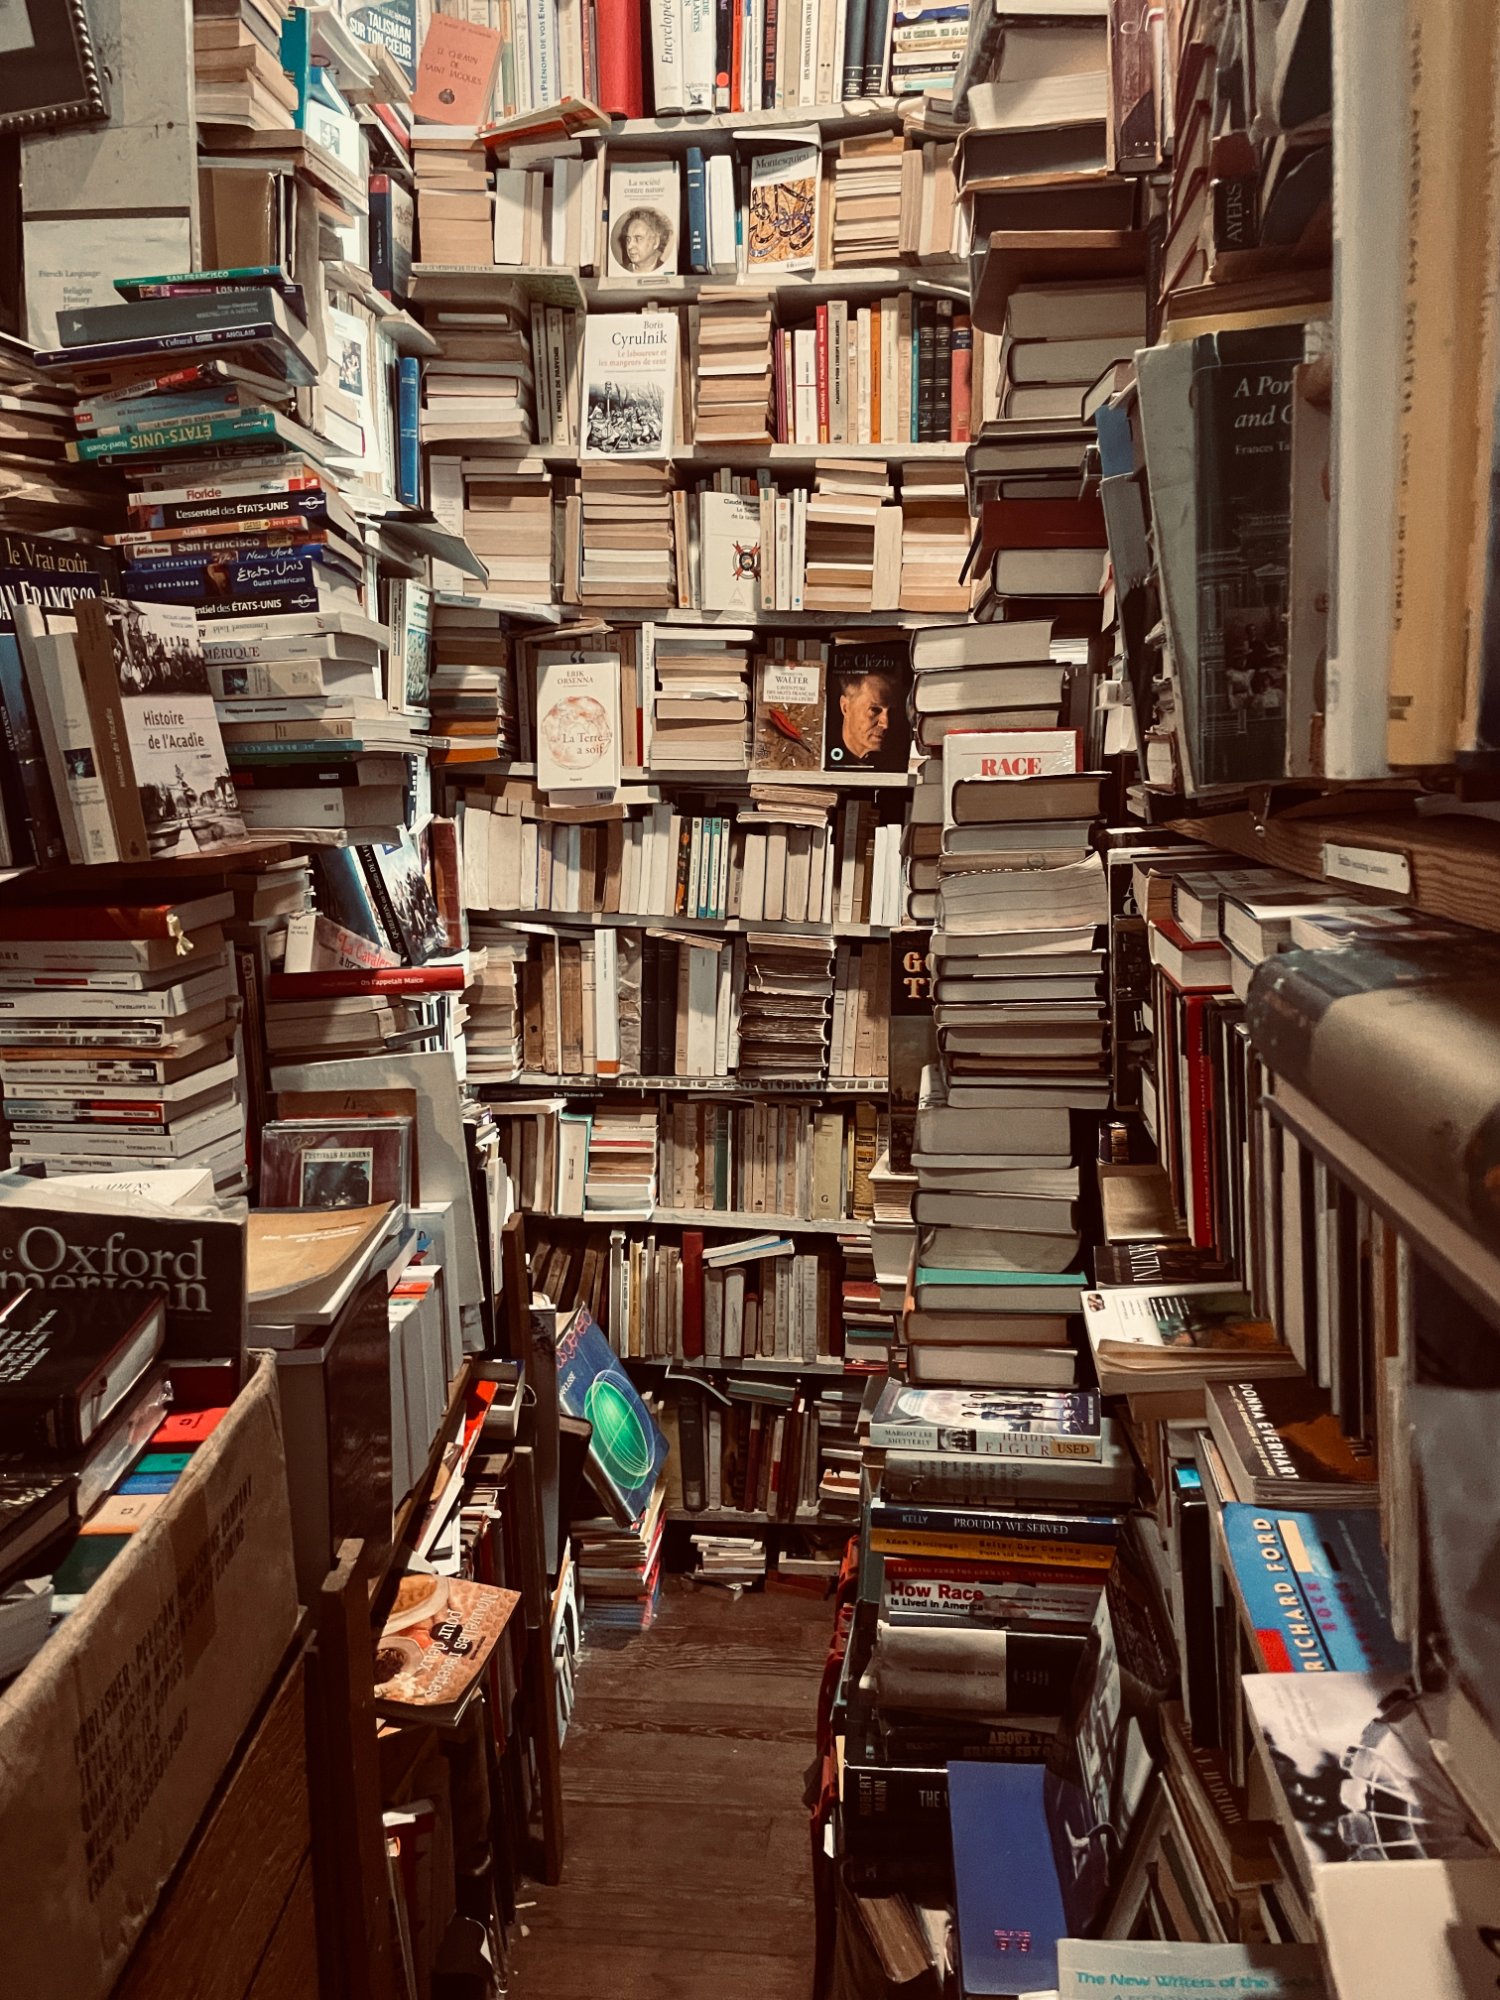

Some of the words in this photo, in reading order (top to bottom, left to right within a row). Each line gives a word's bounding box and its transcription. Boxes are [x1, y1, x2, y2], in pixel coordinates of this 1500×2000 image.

[368, 11, 411, 43] TALISMAN
[349, 17, 366, 39] SUR
[367, 27, 384, 45] TON
[385, 37, 411, 60] CŒUR
[540, 39, 547, 48] DE
[448, 50, 479, 64] CHEMIN
[450, 61, 460, 69] DE
[425, 64, 445, 75] SAINT
[449, 70, 482, 85] JACQUES
[755, 151, 810, 170] Montesquieu
[628, 178, 638, 187] La
[639, 177, 661, 188] société
[623, 187, 643, 195] contre
[645, 186, 665, 194] nature
[1227, 183, 1242, 243] AYERS
[38, 269, 63, 278] French
[64, 269, 101, 279] Language
[166, 273, 185, 282] SAN
[188, 270, 229, 280] FRANCISCO
[63, 287, 92, 297] Religion
[216, 284, 232, 294] LOS
[63, 295, 91, 304] History
[643, 320, 664, 329] Boris
[165, 335, 193, 347] Cultural
[225, 329, 255, 339] ANGLAIS
[611, 331, 667, 352] Cyrulnik
[609, 359, 641, 368] mangeurs
[643, 358, 650, 366] de
[1233, 377, 1251, 398] A
[1235, 403, 1275, 429] and
[129, 423, 213, 449] ÉTATS-UNIS
[86, 440, 128, 452] Nord-Ouest
[1235, 442, 1274, 456] Frances
[186, 487, 222, 501] Floride
[176, 506, 220, 519] L'essentiel
[221, 505, 235, 516] des
[236, 501, 289, 514] ÉTATS-UNIS
[177, 540, 201, 552] San
[203, 537, 260, 550] Francisco
[8, 537, 21, 566] le
[22, 541, 56, 571] Vrai
[246, 550, 266, 561] New
[270, 547, 294, 559] York
[236, 561, 304, 582] États-Unis
[253, 579, 274, 588] Ouest
[274, 577, 306, 587] américain
[216, 604, 231, 614] des
[231, 599, 282, 612] ÉTATS-UNIS
[212, 624, 231, 634] Todd
[833, 654, 850, 668] Le
[854, 653, 895, 668] Clézio
[557, 677, 594, 685] ORSENNA
[566, 670, 584, 678] ERIK
[775, 676, 809, 685] WALTER
[143, 709, 186, 728] Histoire
[147, 736, 162, 750] de
[163, 733, 205, 750] l'Acadie
[562, 733, 574, 743] La
[575, 732, 604, 743] Terre
[585, 744, 604, 754] soif
[981, 757, 1042, 777] RACE
[371, 976, 403, 987] l'appelait
[18, 1225, 208, 1281] Oxford
[885, 1429, 916, 1438] MARGOT
[918, 1430, 932, 1438] LEE
[1239, 1383, 1267, 1419] DONNA
[1258, 1422, 1300, 1479] EVERHART
[888, 1437, 931, 1446] SHETTERLY
[1057, 1443, 1090, 1455] USED
[902, 1515, 928, 1524] KELLY
[953, 1518, 1001, 1531] PROUDLY
[1005, 1521, 1024, 1532] WE
[1026, 1523, 1069, 1535] SERVED
[886, 1538, 909, 1546] Adam
[1017, 1541, 1037, 1552] Day
[1041, 1543, 1081, 1555] Coming
[1252, 1517, 1288, 1573] FORD
[890, 1581, 932, 1597] How
[938, 1584, 985, 1600] Race
[890, 1597, 900, 1606] Is
[902, 1597, 928, 1608] Lived
[942, 1600, 984, 1611] America
[437, 1608, 463, 1641] pour
[454, 1592, 500, 1650] Nouvelles
[1274, 1582, 1325, 1672] RICHARD
[418, 1641, 448, 1673] deux
[424, 1652, 461, 1698] recettes
[920, 1790, 941, 1808] THE
[1076, 1971, 1105, 1984] The
[1110, 1974, 1150, 1987] New
[1155, 1975, 1216, 1989] Writers
[1220, 1976, 1236, 1988] of
[1241, 1976, 1269, 1989] the
